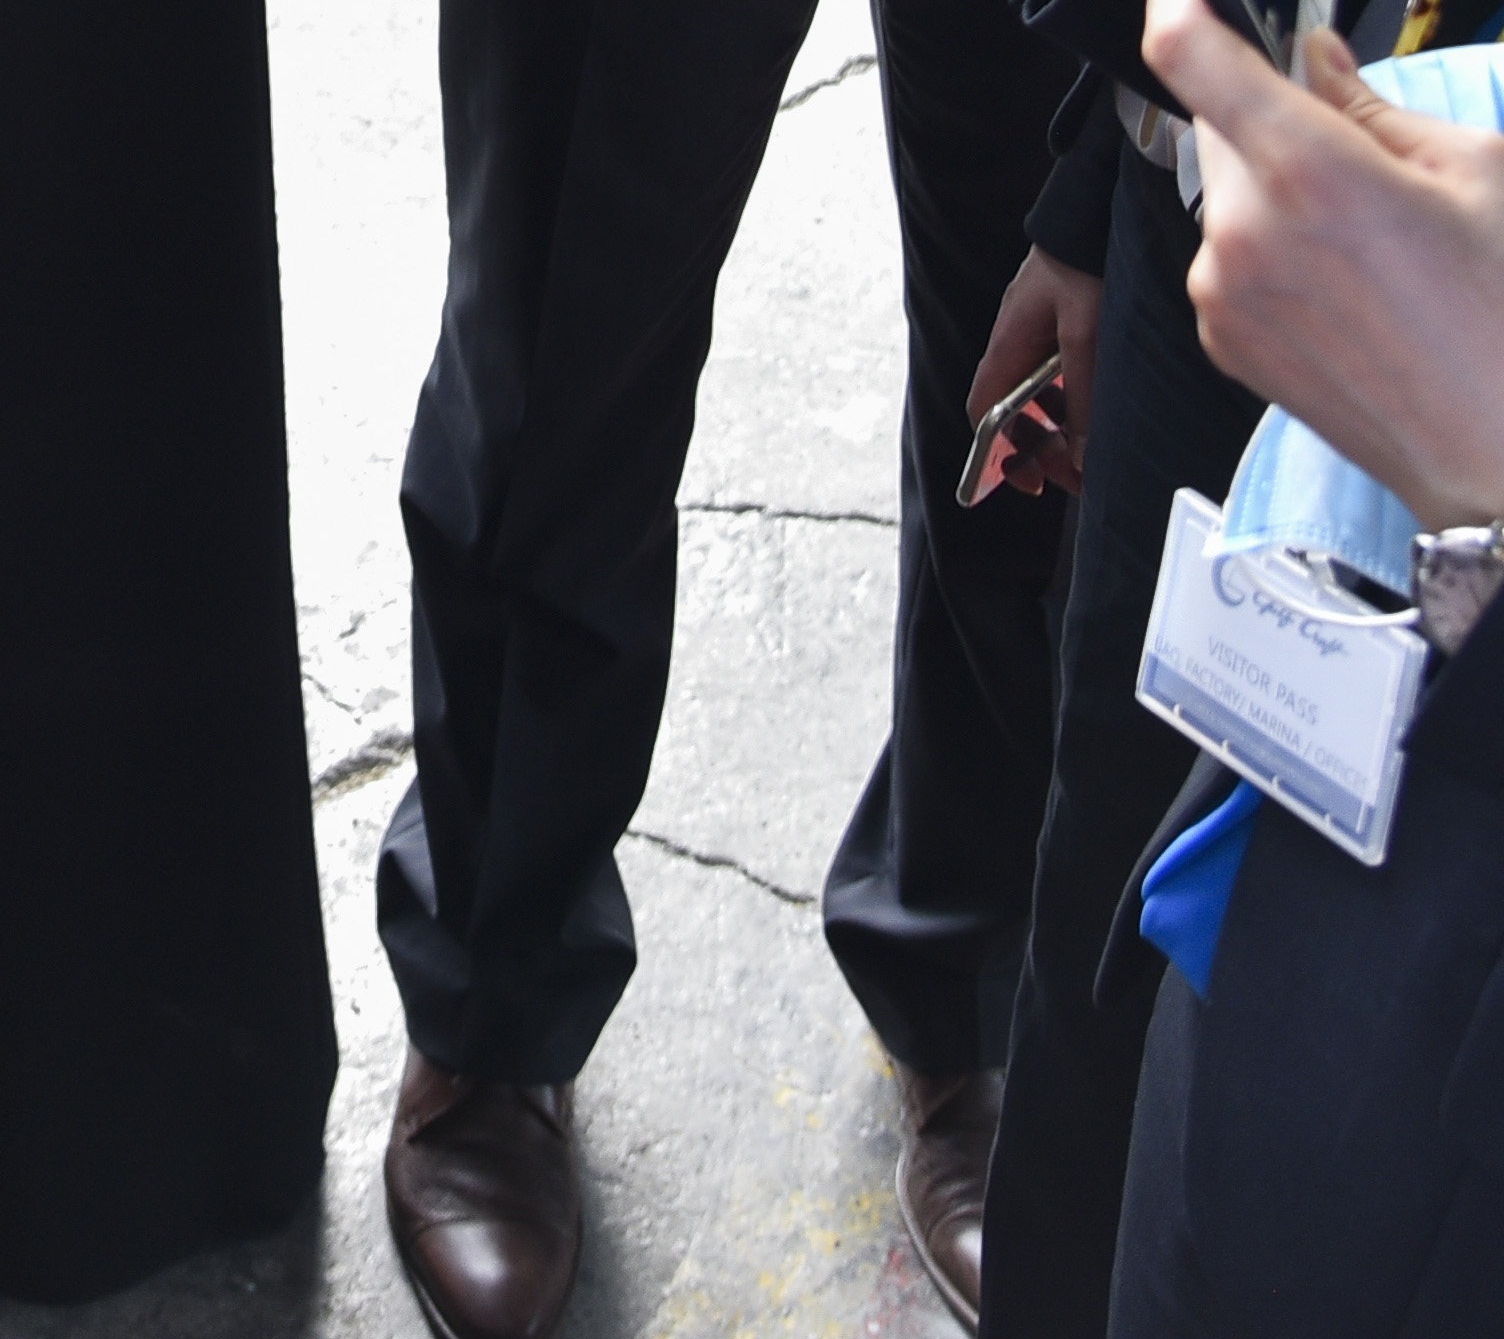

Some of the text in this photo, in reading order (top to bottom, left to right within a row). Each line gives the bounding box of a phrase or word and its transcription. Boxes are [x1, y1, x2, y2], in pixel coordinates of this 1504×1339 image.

[1207, 634, 1319, 726] VISITOR PASS
[1247, 701, 1301, 751] MARINA
